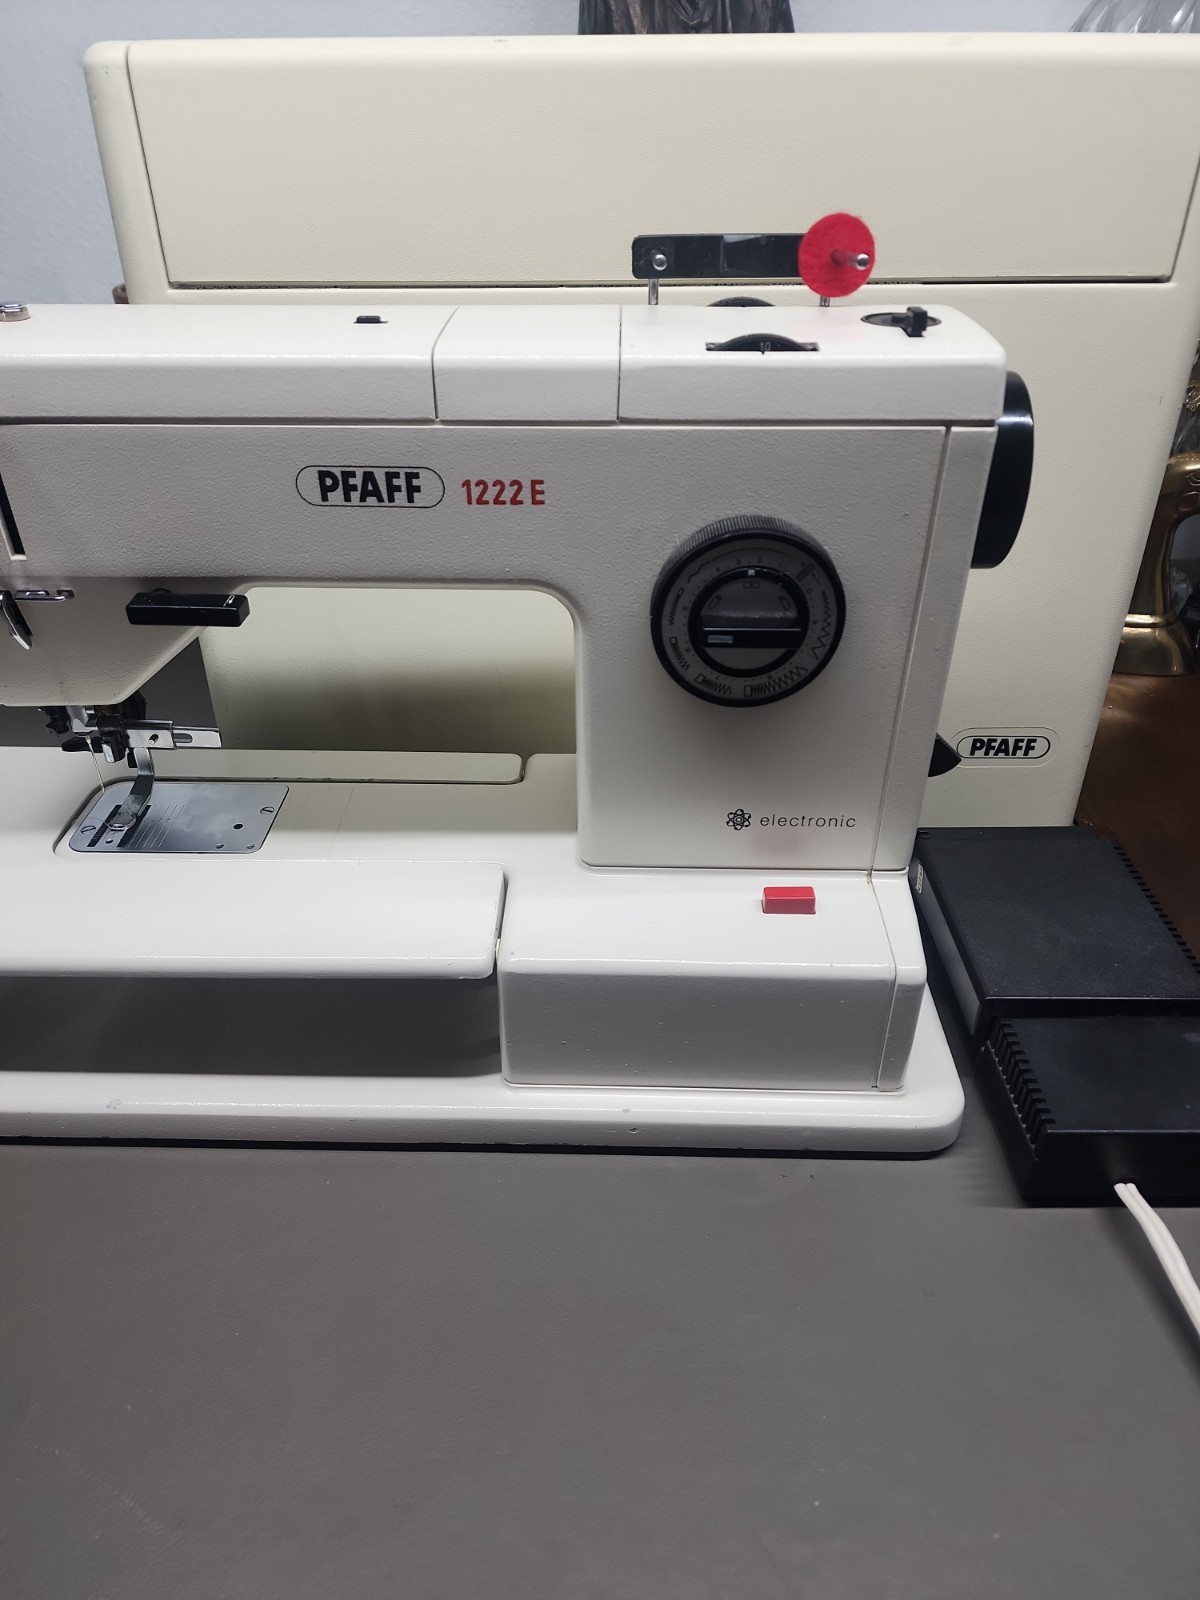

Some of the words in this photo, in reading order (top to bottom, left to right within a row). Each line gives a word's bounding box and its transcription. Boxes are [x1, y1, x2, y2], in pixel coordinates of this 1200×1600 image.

[760, 341, 771, 352] 10
[317, 470, 422, 504] PFAFF
[969, 738, 1037, 757] PFAFF
[759, 813, 857, 829] electronic
